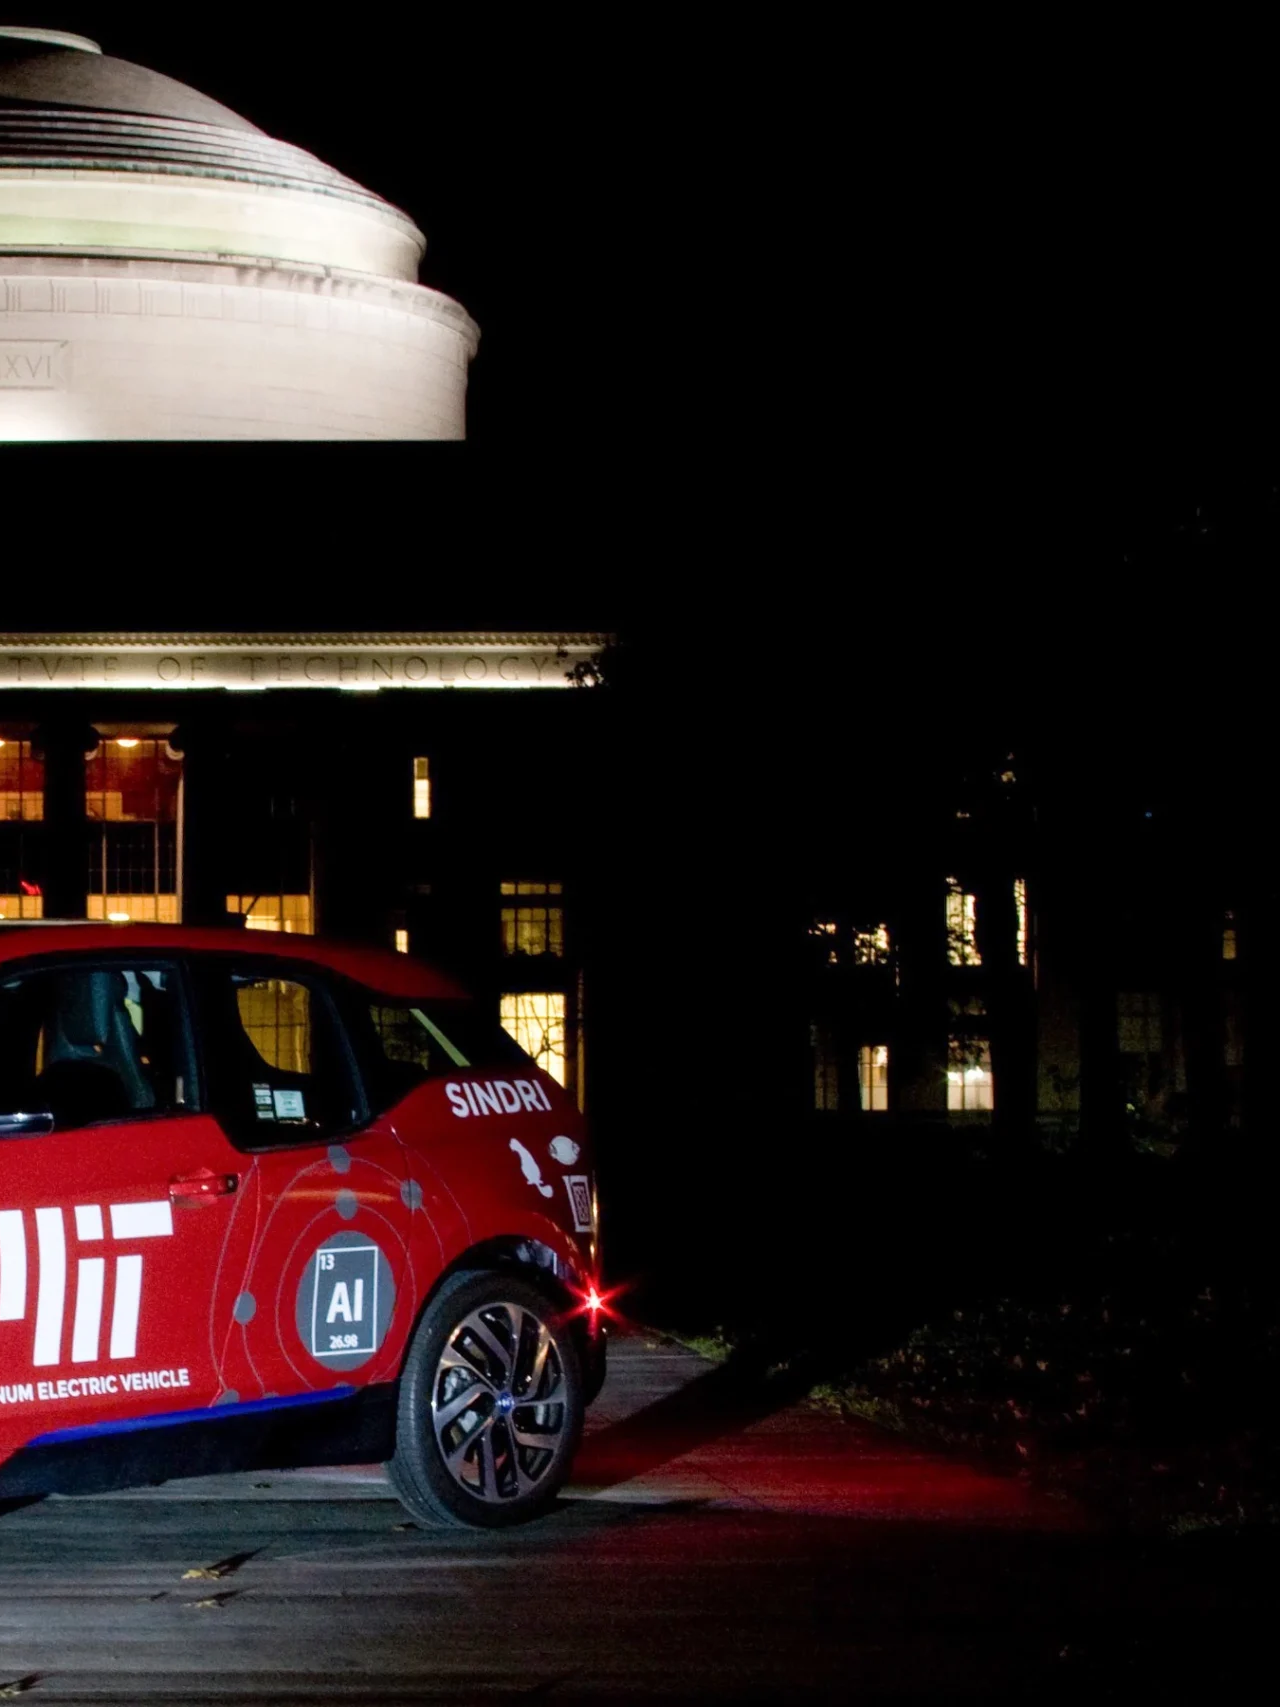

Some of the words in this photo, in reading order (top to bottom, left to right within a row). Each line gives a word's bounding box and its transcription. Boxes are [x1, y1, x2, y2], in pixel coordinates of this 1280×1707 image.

[155, 656, 207, 682] OF
[240, 654, 549, 682] TECHNOLOGY
[445, 1079, 552, 1118] SINDRI
[320, 1253, 335, 1271] 13
[329, 1334, 359, 1350] 26.98
[36, 1375, 119, 1401] ELECTRIC
[119, 1368, 190, 1392] VEHICLE
